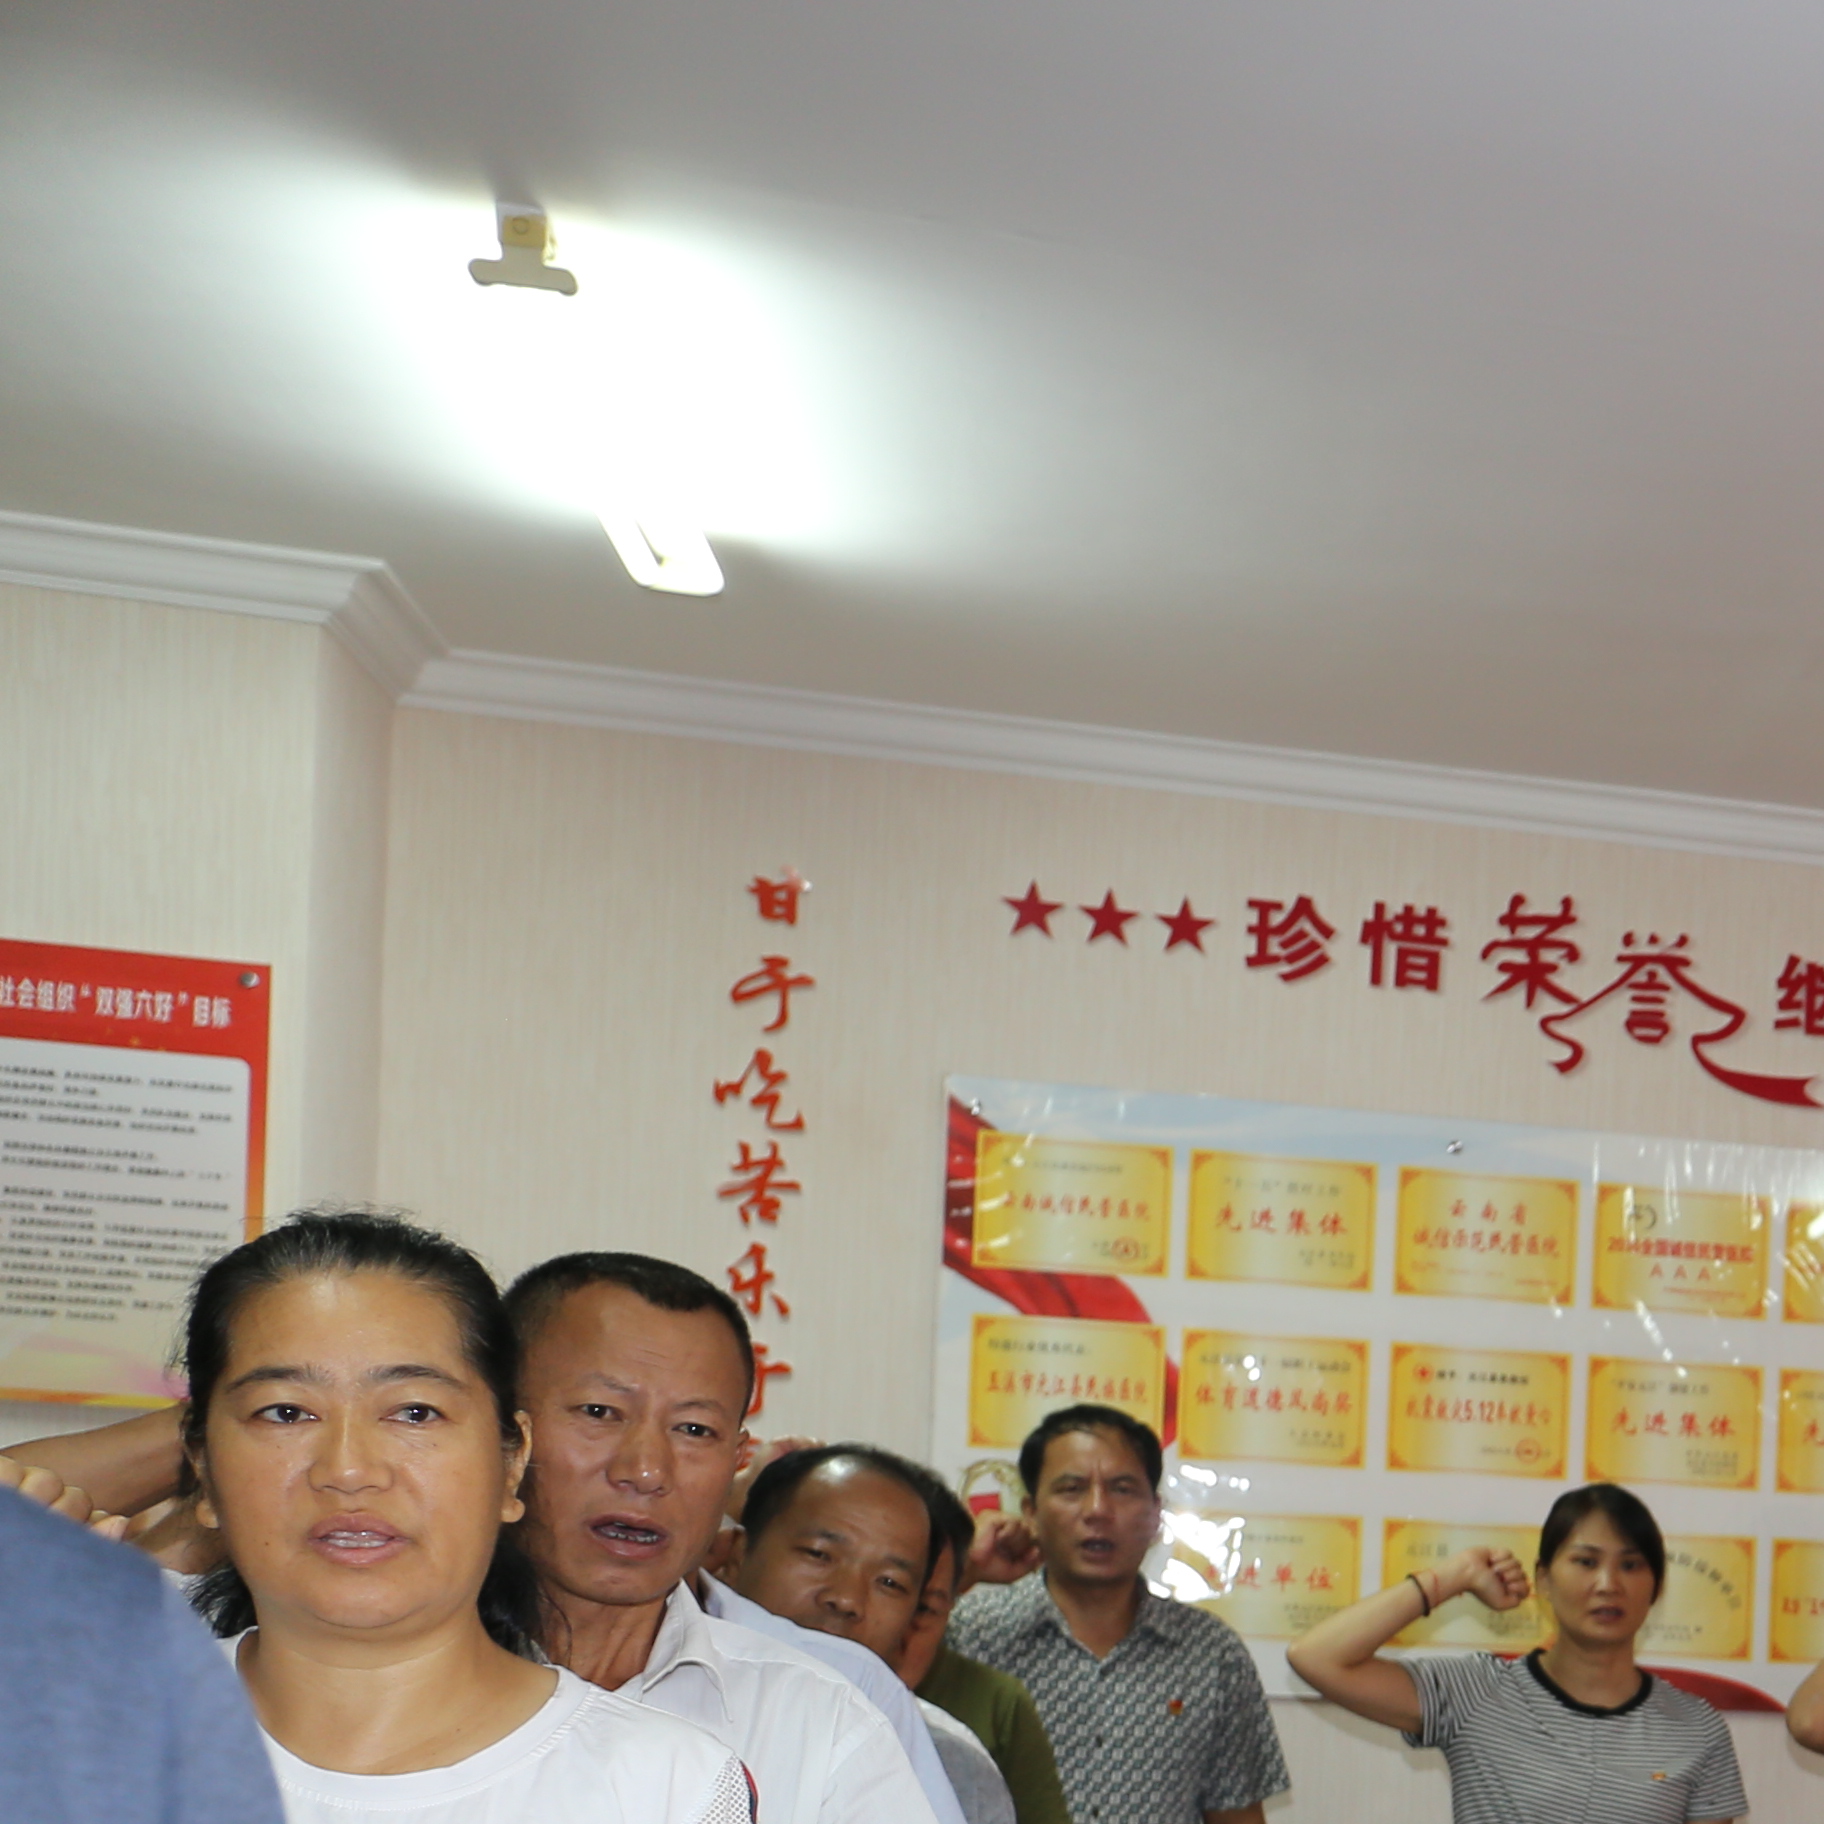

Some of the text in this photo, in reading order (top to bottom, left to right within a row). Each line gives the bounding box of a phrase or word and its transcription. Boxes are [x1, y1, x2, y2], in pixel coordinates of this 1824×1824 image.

[712, 872, 816, 1472] 甘于吃苦乐于
[1216, 1204, 1348, 1237] 先进集体
[1611, 1406, 1736, 1438] 先进集体
